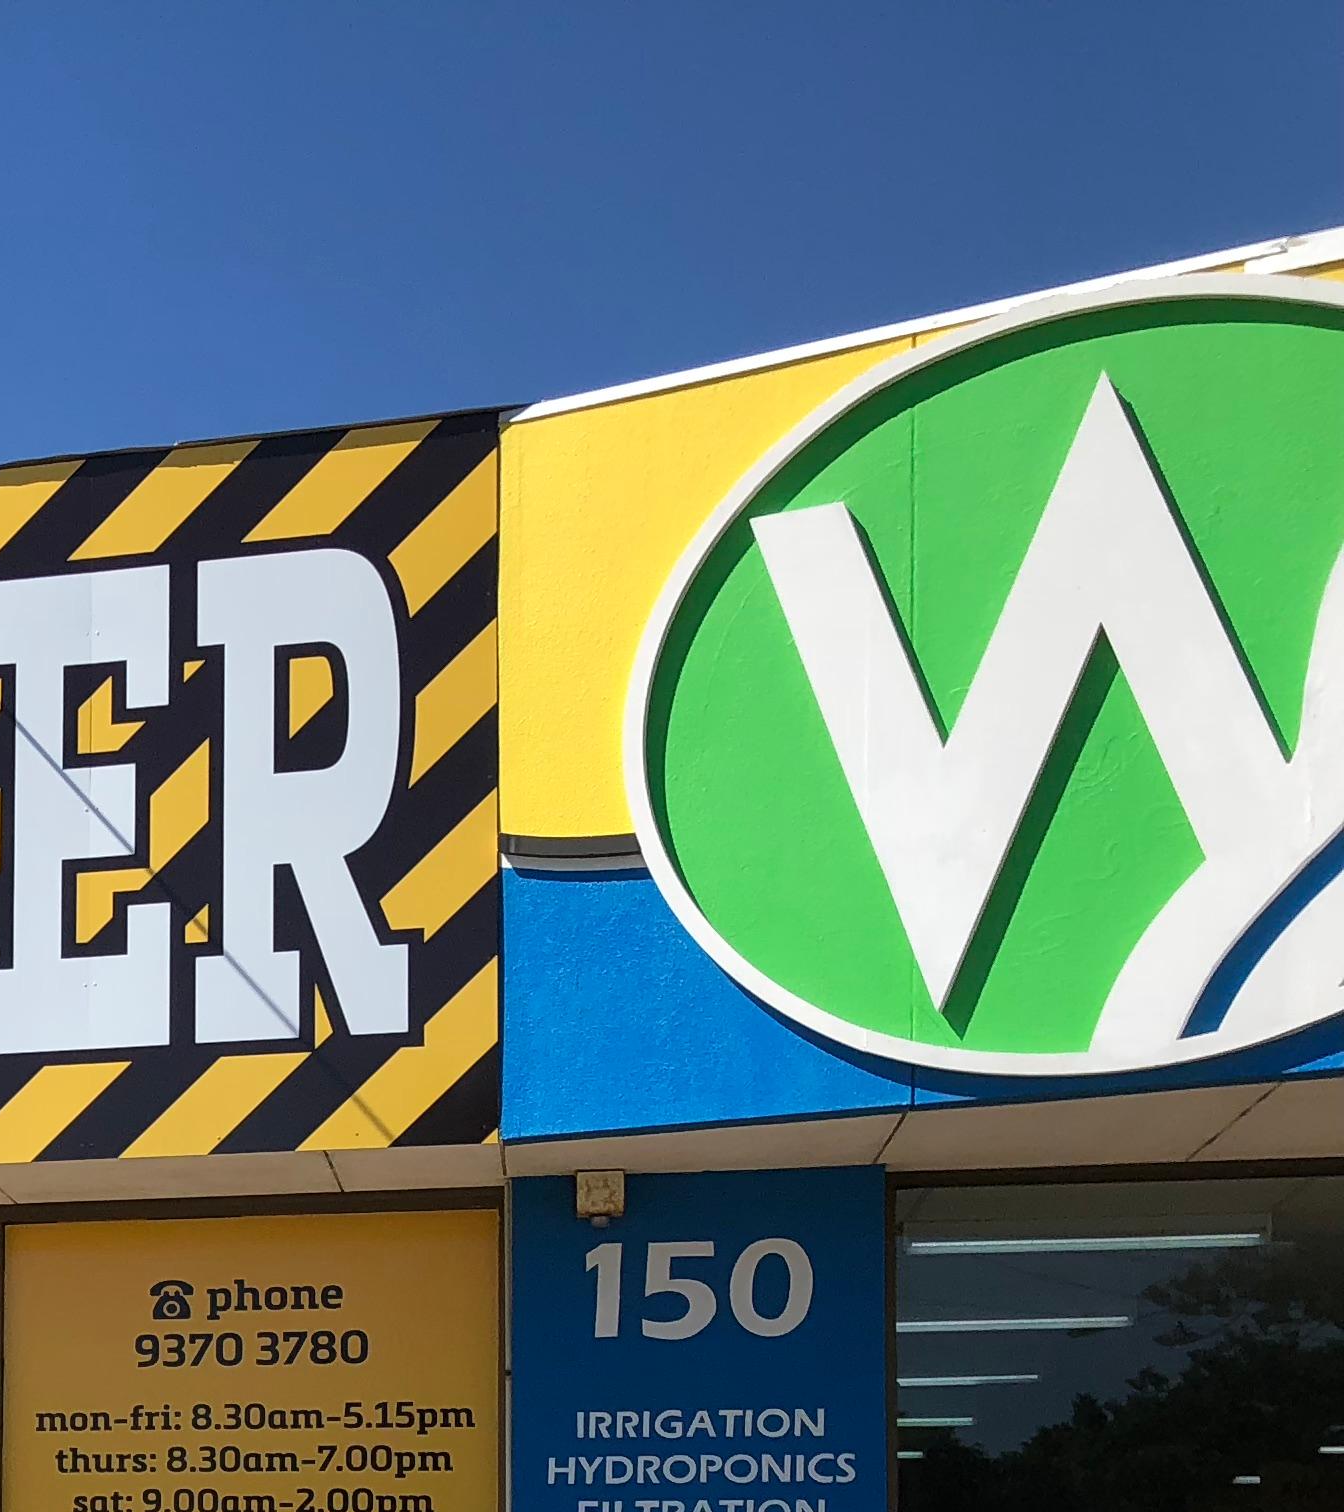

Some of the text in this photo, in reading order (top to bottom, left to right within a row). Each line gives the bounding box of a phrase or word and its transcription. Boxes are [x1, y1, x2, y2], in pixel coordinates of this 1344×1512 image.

[206, 1279, 343, 1320] phone
[585, 1237, 813, 1340] 150
[135, 1329, 369, 1368] 9370 3780
[35, 1401, 475, 1434] mon-fri: 8.30am-5.15pm
[576, 1408, 825, 1439] IRRIGATION
[55, 1444, 453, 1478] thurs: 8.30am-7.00pm
[547, 1453, 856, 1485] HYDROPONICS
